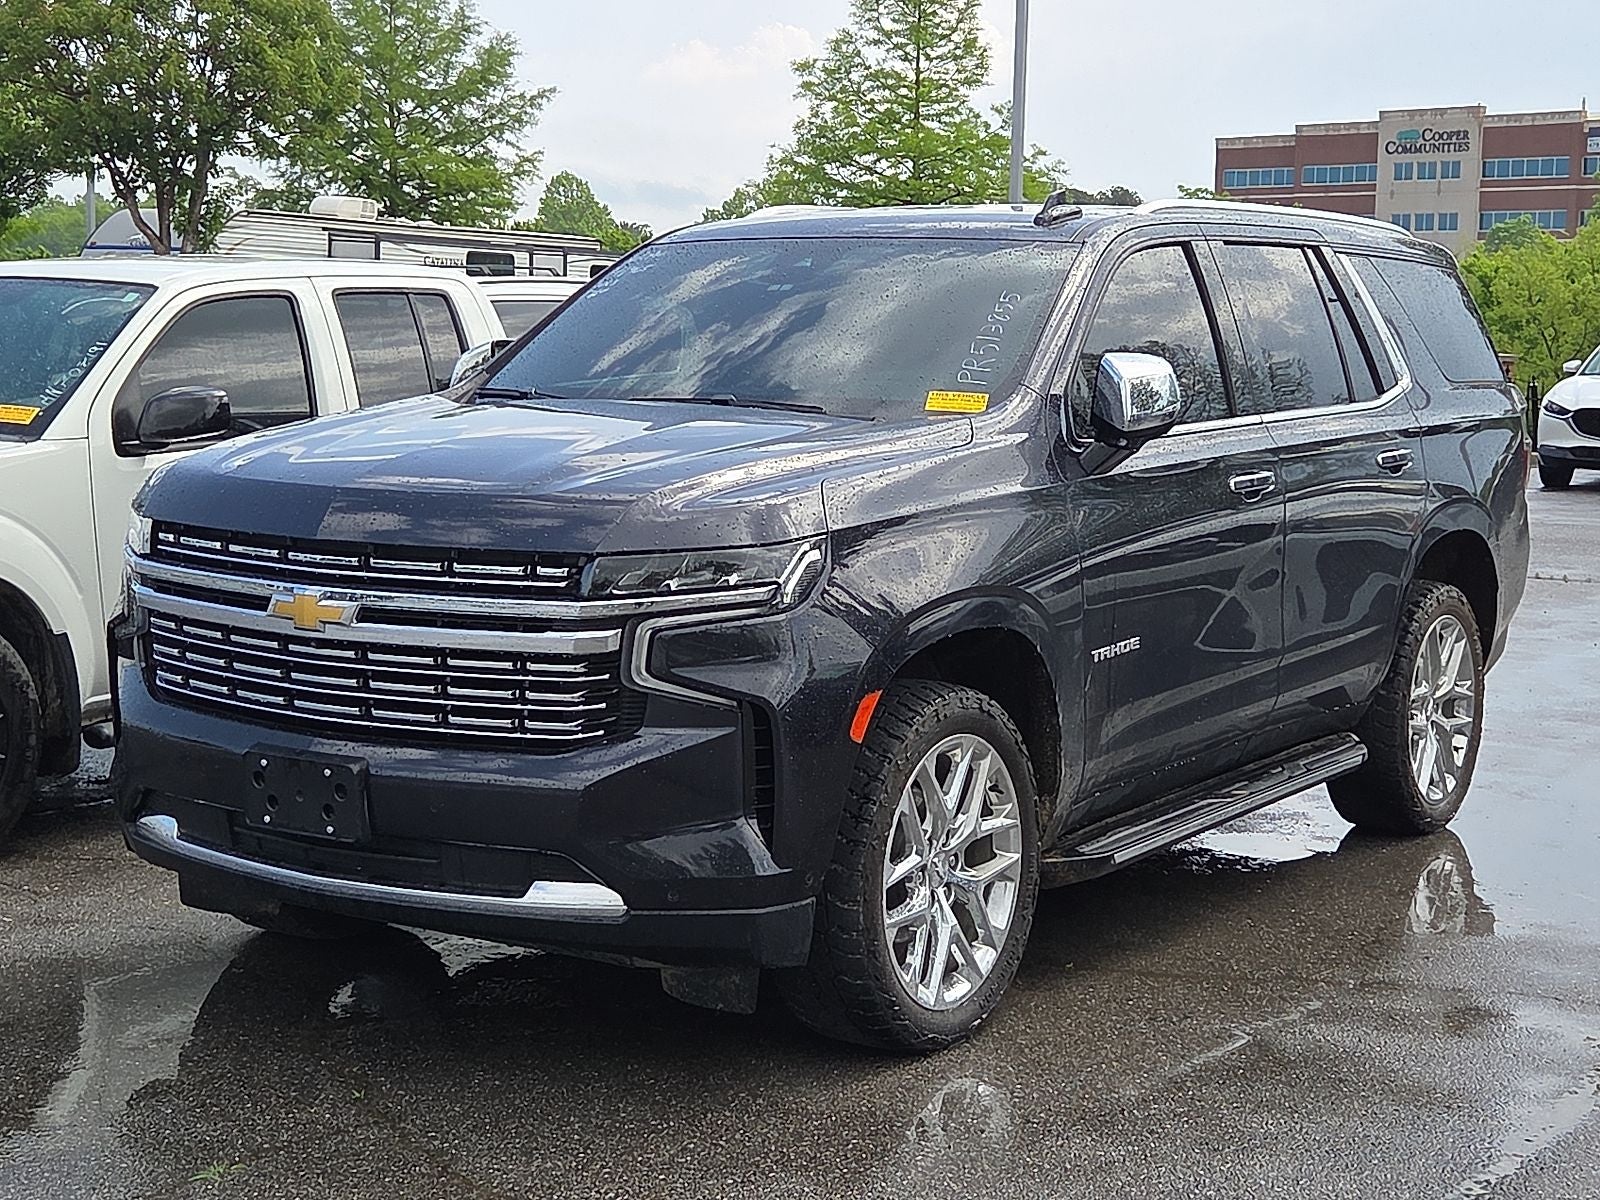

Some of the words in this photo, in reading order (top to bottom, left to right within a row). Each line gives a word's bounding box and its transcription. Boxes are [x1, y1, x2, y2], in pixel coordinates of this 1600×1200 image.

[1422, 128, 1470, 142] COOPER
[1385, 141, 1470, 155] COMMUNITIES
[957, 290, 1021, 385] PR513855
[1090, 636, 1141, 663] TAHOE
